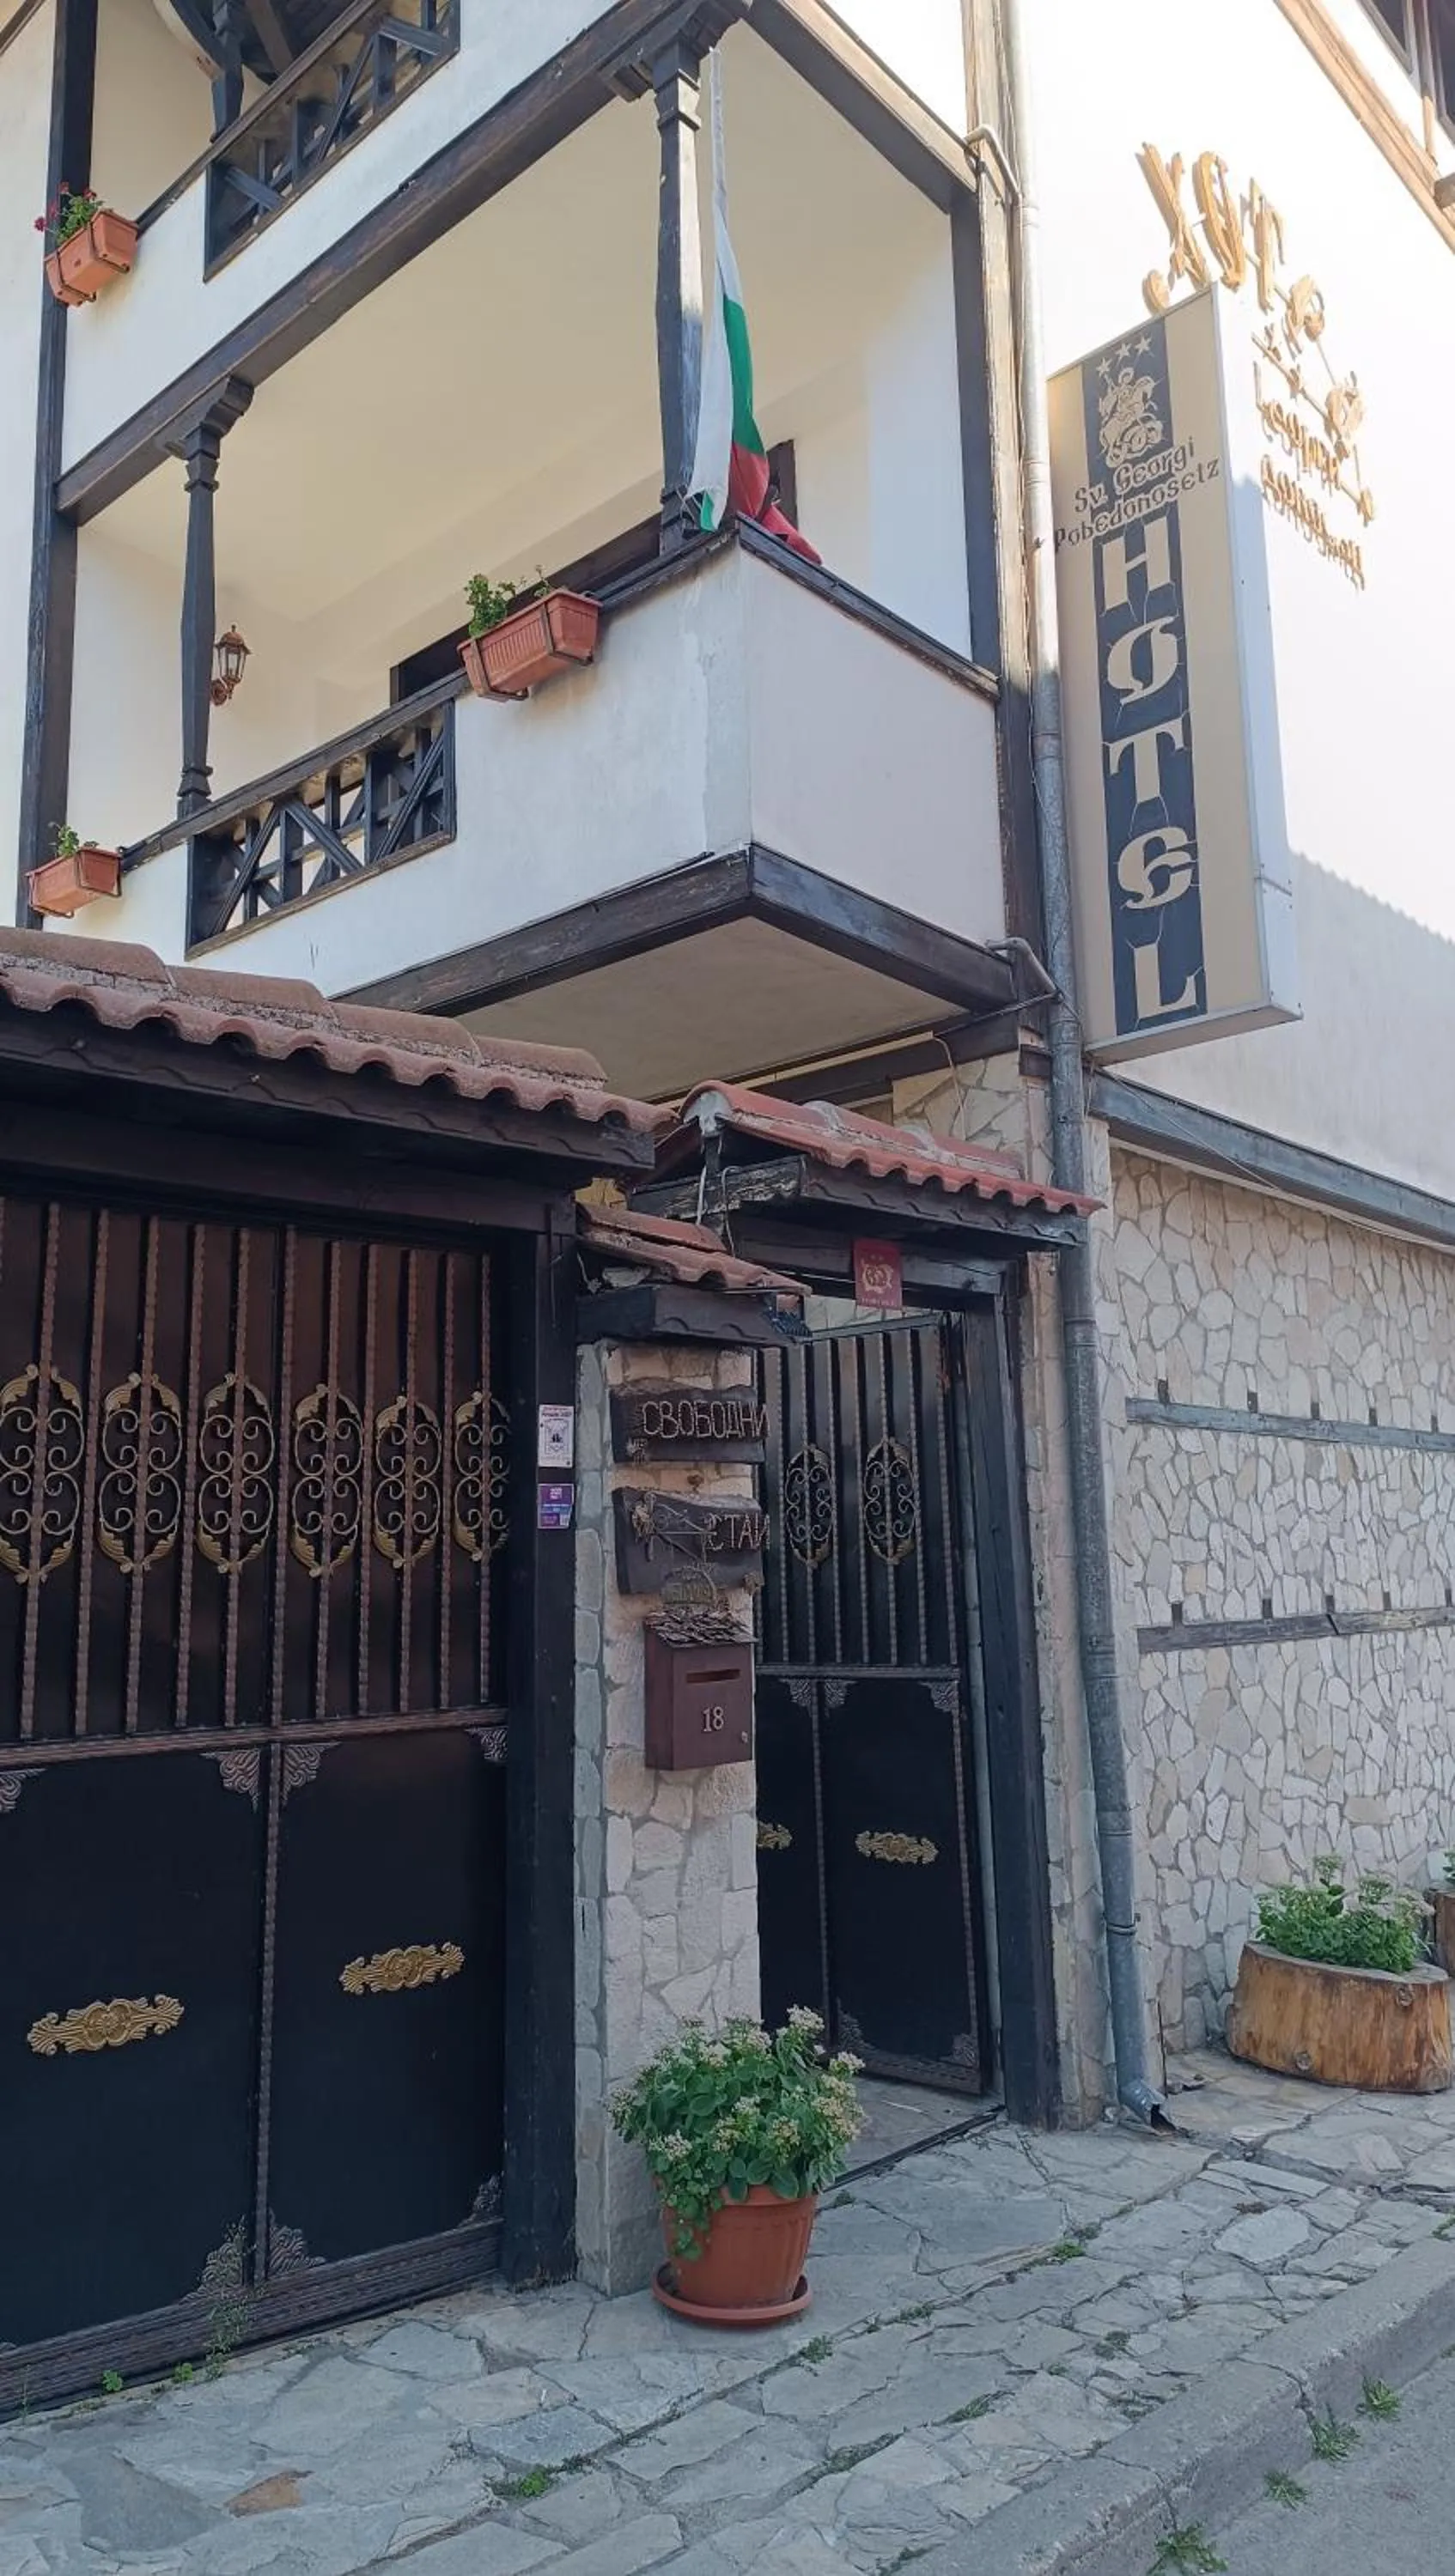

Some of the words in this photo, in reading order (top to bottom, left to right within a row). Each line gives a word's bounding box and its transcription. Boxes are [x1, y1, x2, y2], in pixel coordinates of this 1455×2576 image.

[1116, 435, 1194, 493] Georgi
[1102, 516, 1197, 1018] HOTEL
[642, 1400, 770, 1439] СВОБОДНИ
[703, 1705, 725, 1733] 18
